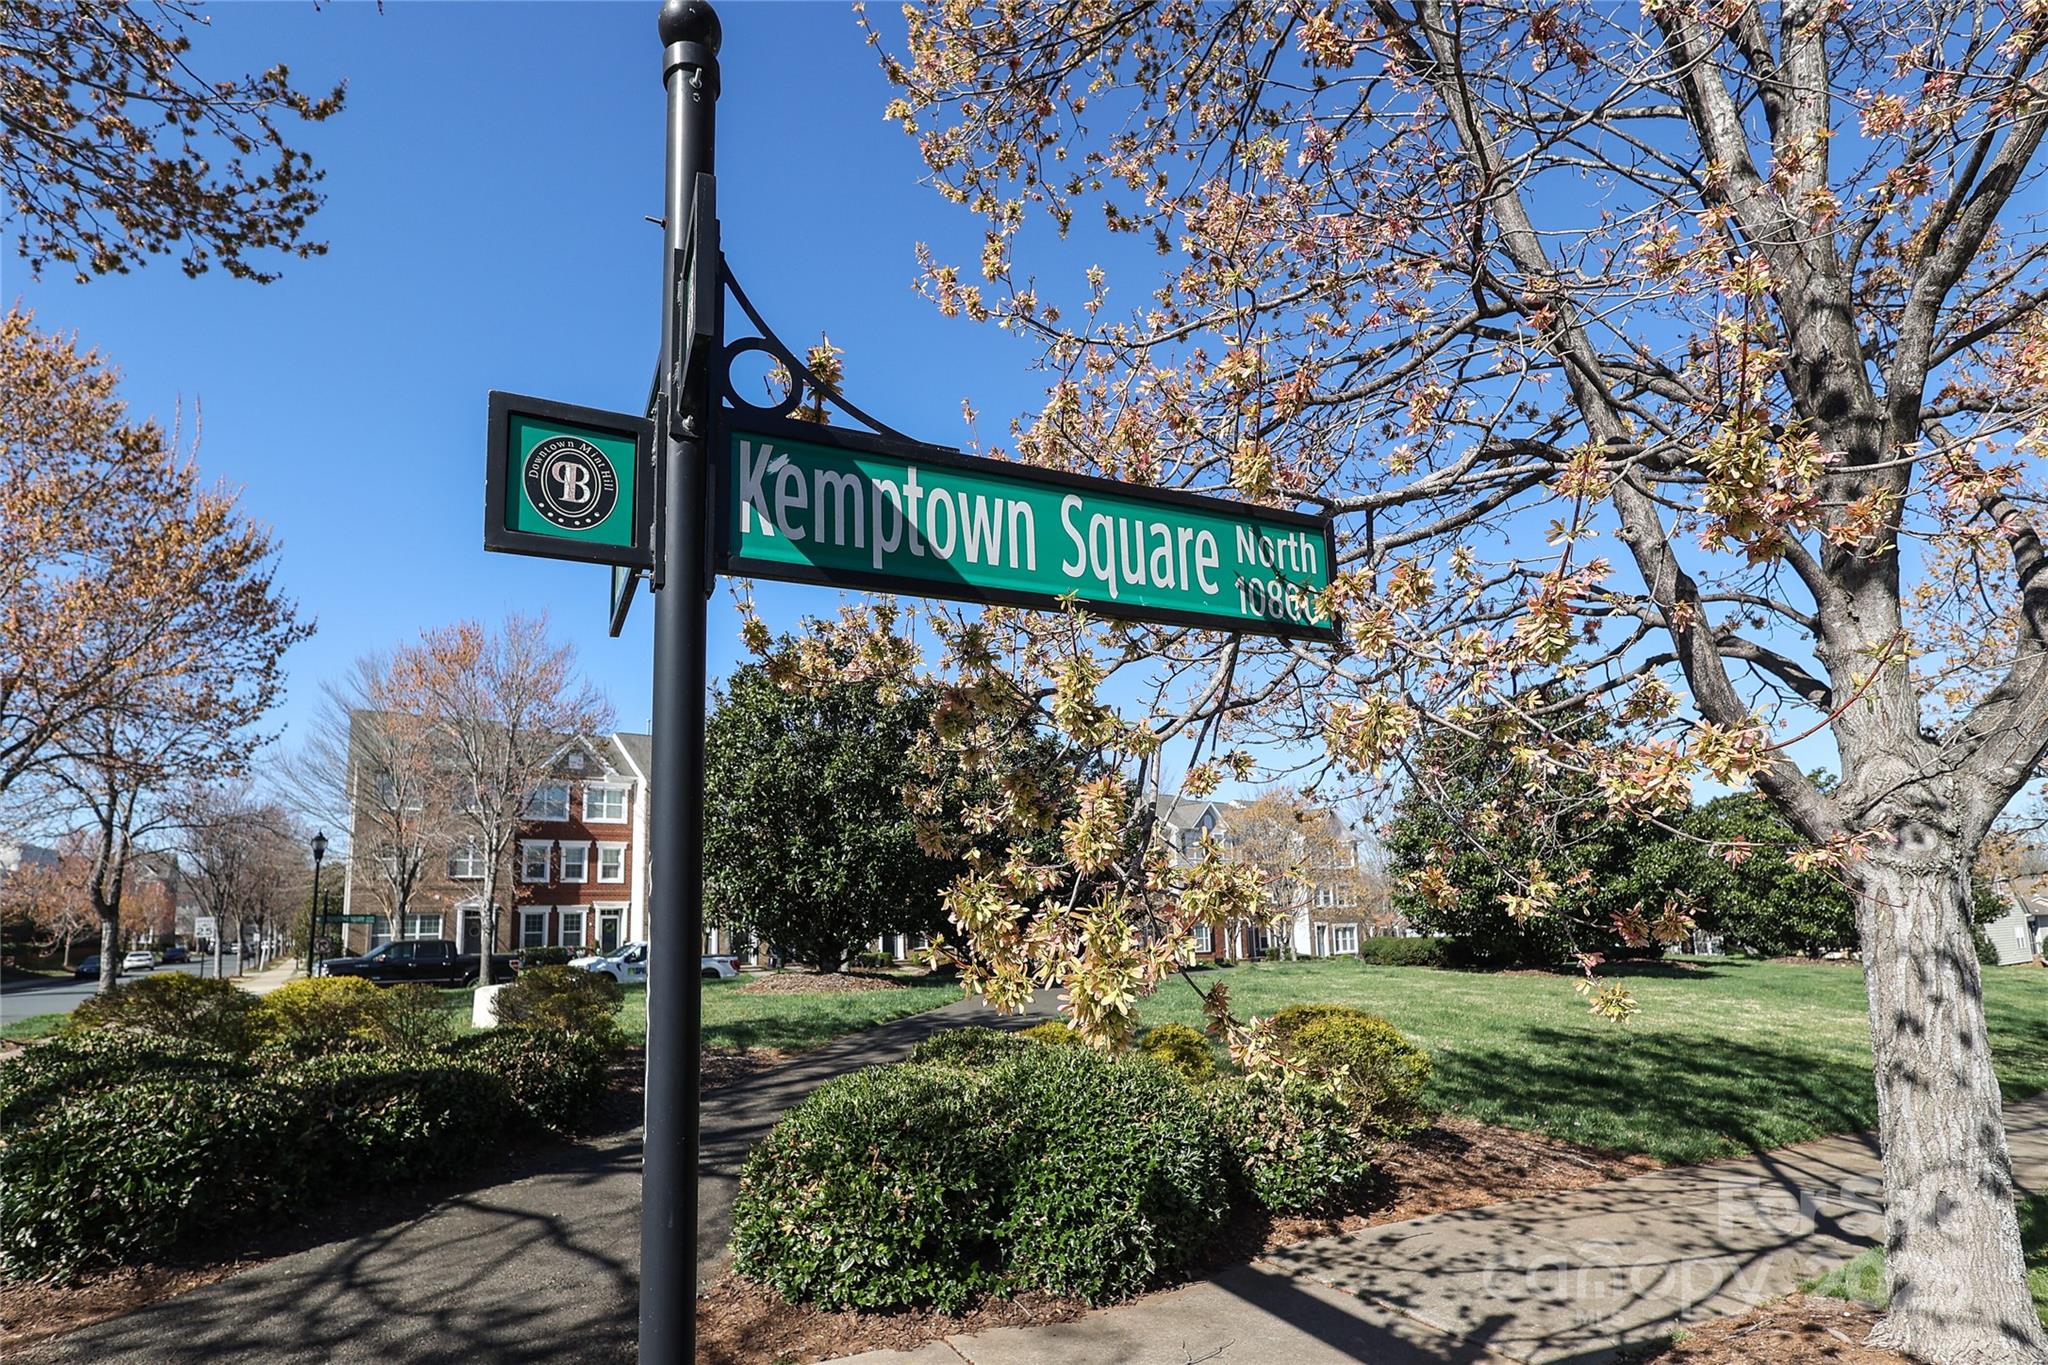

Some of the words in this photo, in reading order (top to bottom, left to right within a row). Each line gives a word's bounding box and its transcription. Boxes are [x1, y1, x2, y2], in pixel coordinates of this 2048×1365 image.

[528, 439, 575, 480] Downtown
[578, 442, 606, 468] Mint
[600, 469, 615, 492] Hill
[738, 438, 1038, 572] Kemptown
[1060, 492, 1221, 601] Square
[1234, 524, 1319, 575] North
[196, 927, 213, 936] 25
